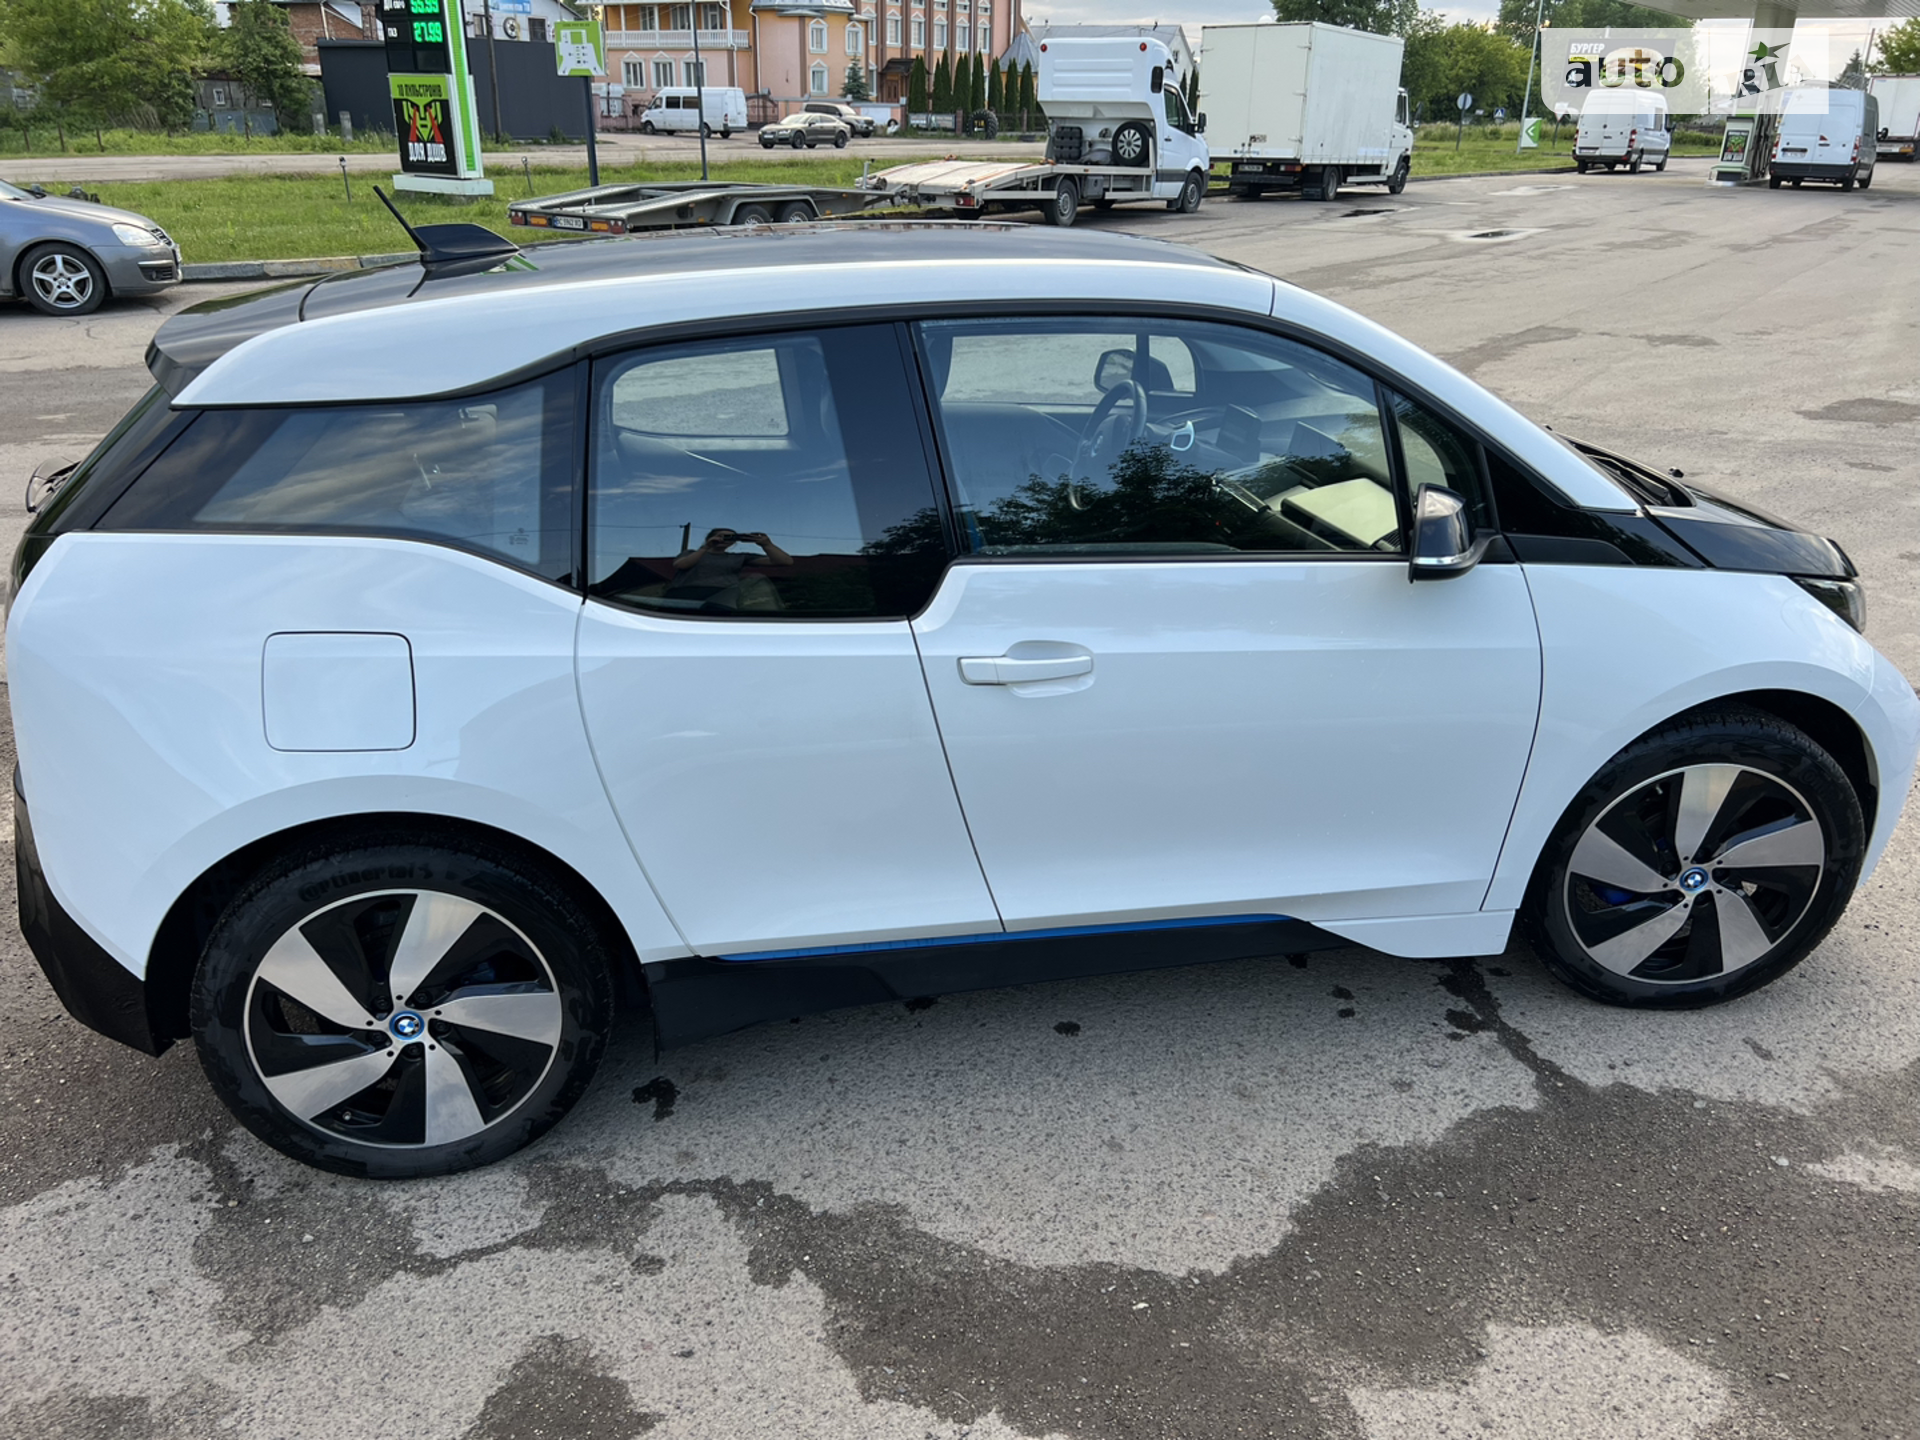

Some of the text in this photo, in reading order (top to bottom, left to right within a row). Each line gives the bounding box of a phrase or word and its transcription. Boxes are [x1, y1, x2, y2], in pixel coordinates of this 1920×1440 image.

[413, 21, 443, 43] 27.99
[1570, 43, 1605, 54] БУРГЕР
[408, 142, 426, 161] ДЛЯ
